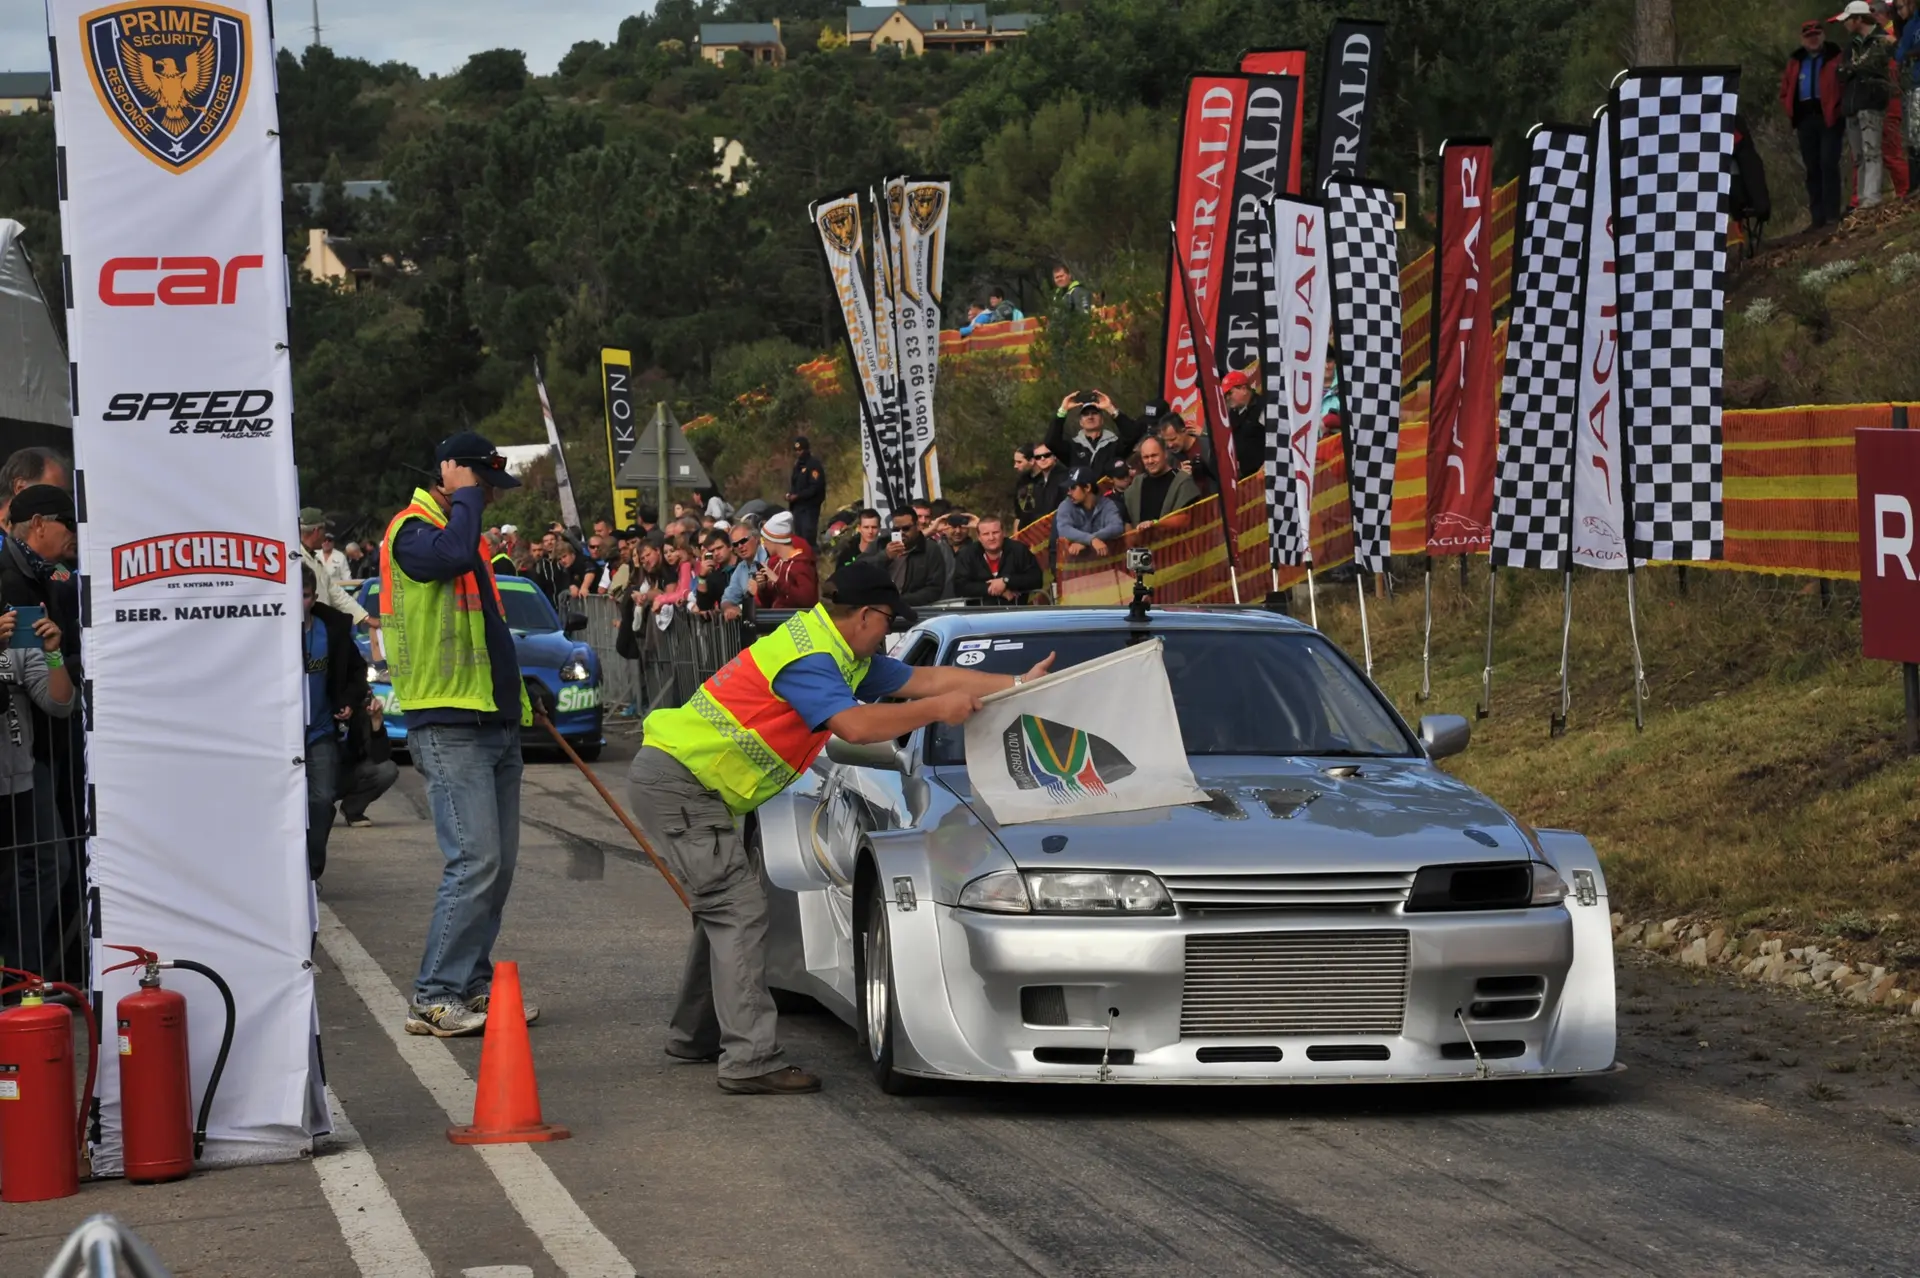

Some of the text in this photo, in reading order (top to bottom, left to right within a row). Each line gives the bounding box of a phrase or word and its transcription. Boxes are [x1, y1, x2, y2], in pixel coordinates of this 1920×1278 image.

[120, 10, 210, 36] PRIME
[133, 33, 204, 47] SECURITY
[106, 67, 154, 135] RESPONSE
[199, 74, 232, 134] OFFICERS
[98, 255, 263, 307] car
[902, 307, 917, 330] 99
[905, 335, 921, 358] 33
[909, 364, 924, 387] 99
[1291, 213, 1316, 511] JAGUAR
[102, 390, 274, 421] SPEED
[914, 391, 929, 441] (0861)
[169, 418, 273, 434] & SOUND
[610, 373, 634, 467] IKON
[221, 431, 272, 439] MAGAZINE
[1874, 493, 1920, 581] R
[119, 536, 281, 581] MITCHELL'S
[115, 603, 286, 622] BEER. NATURALLY.
[965, 653, 978, 663] 25
